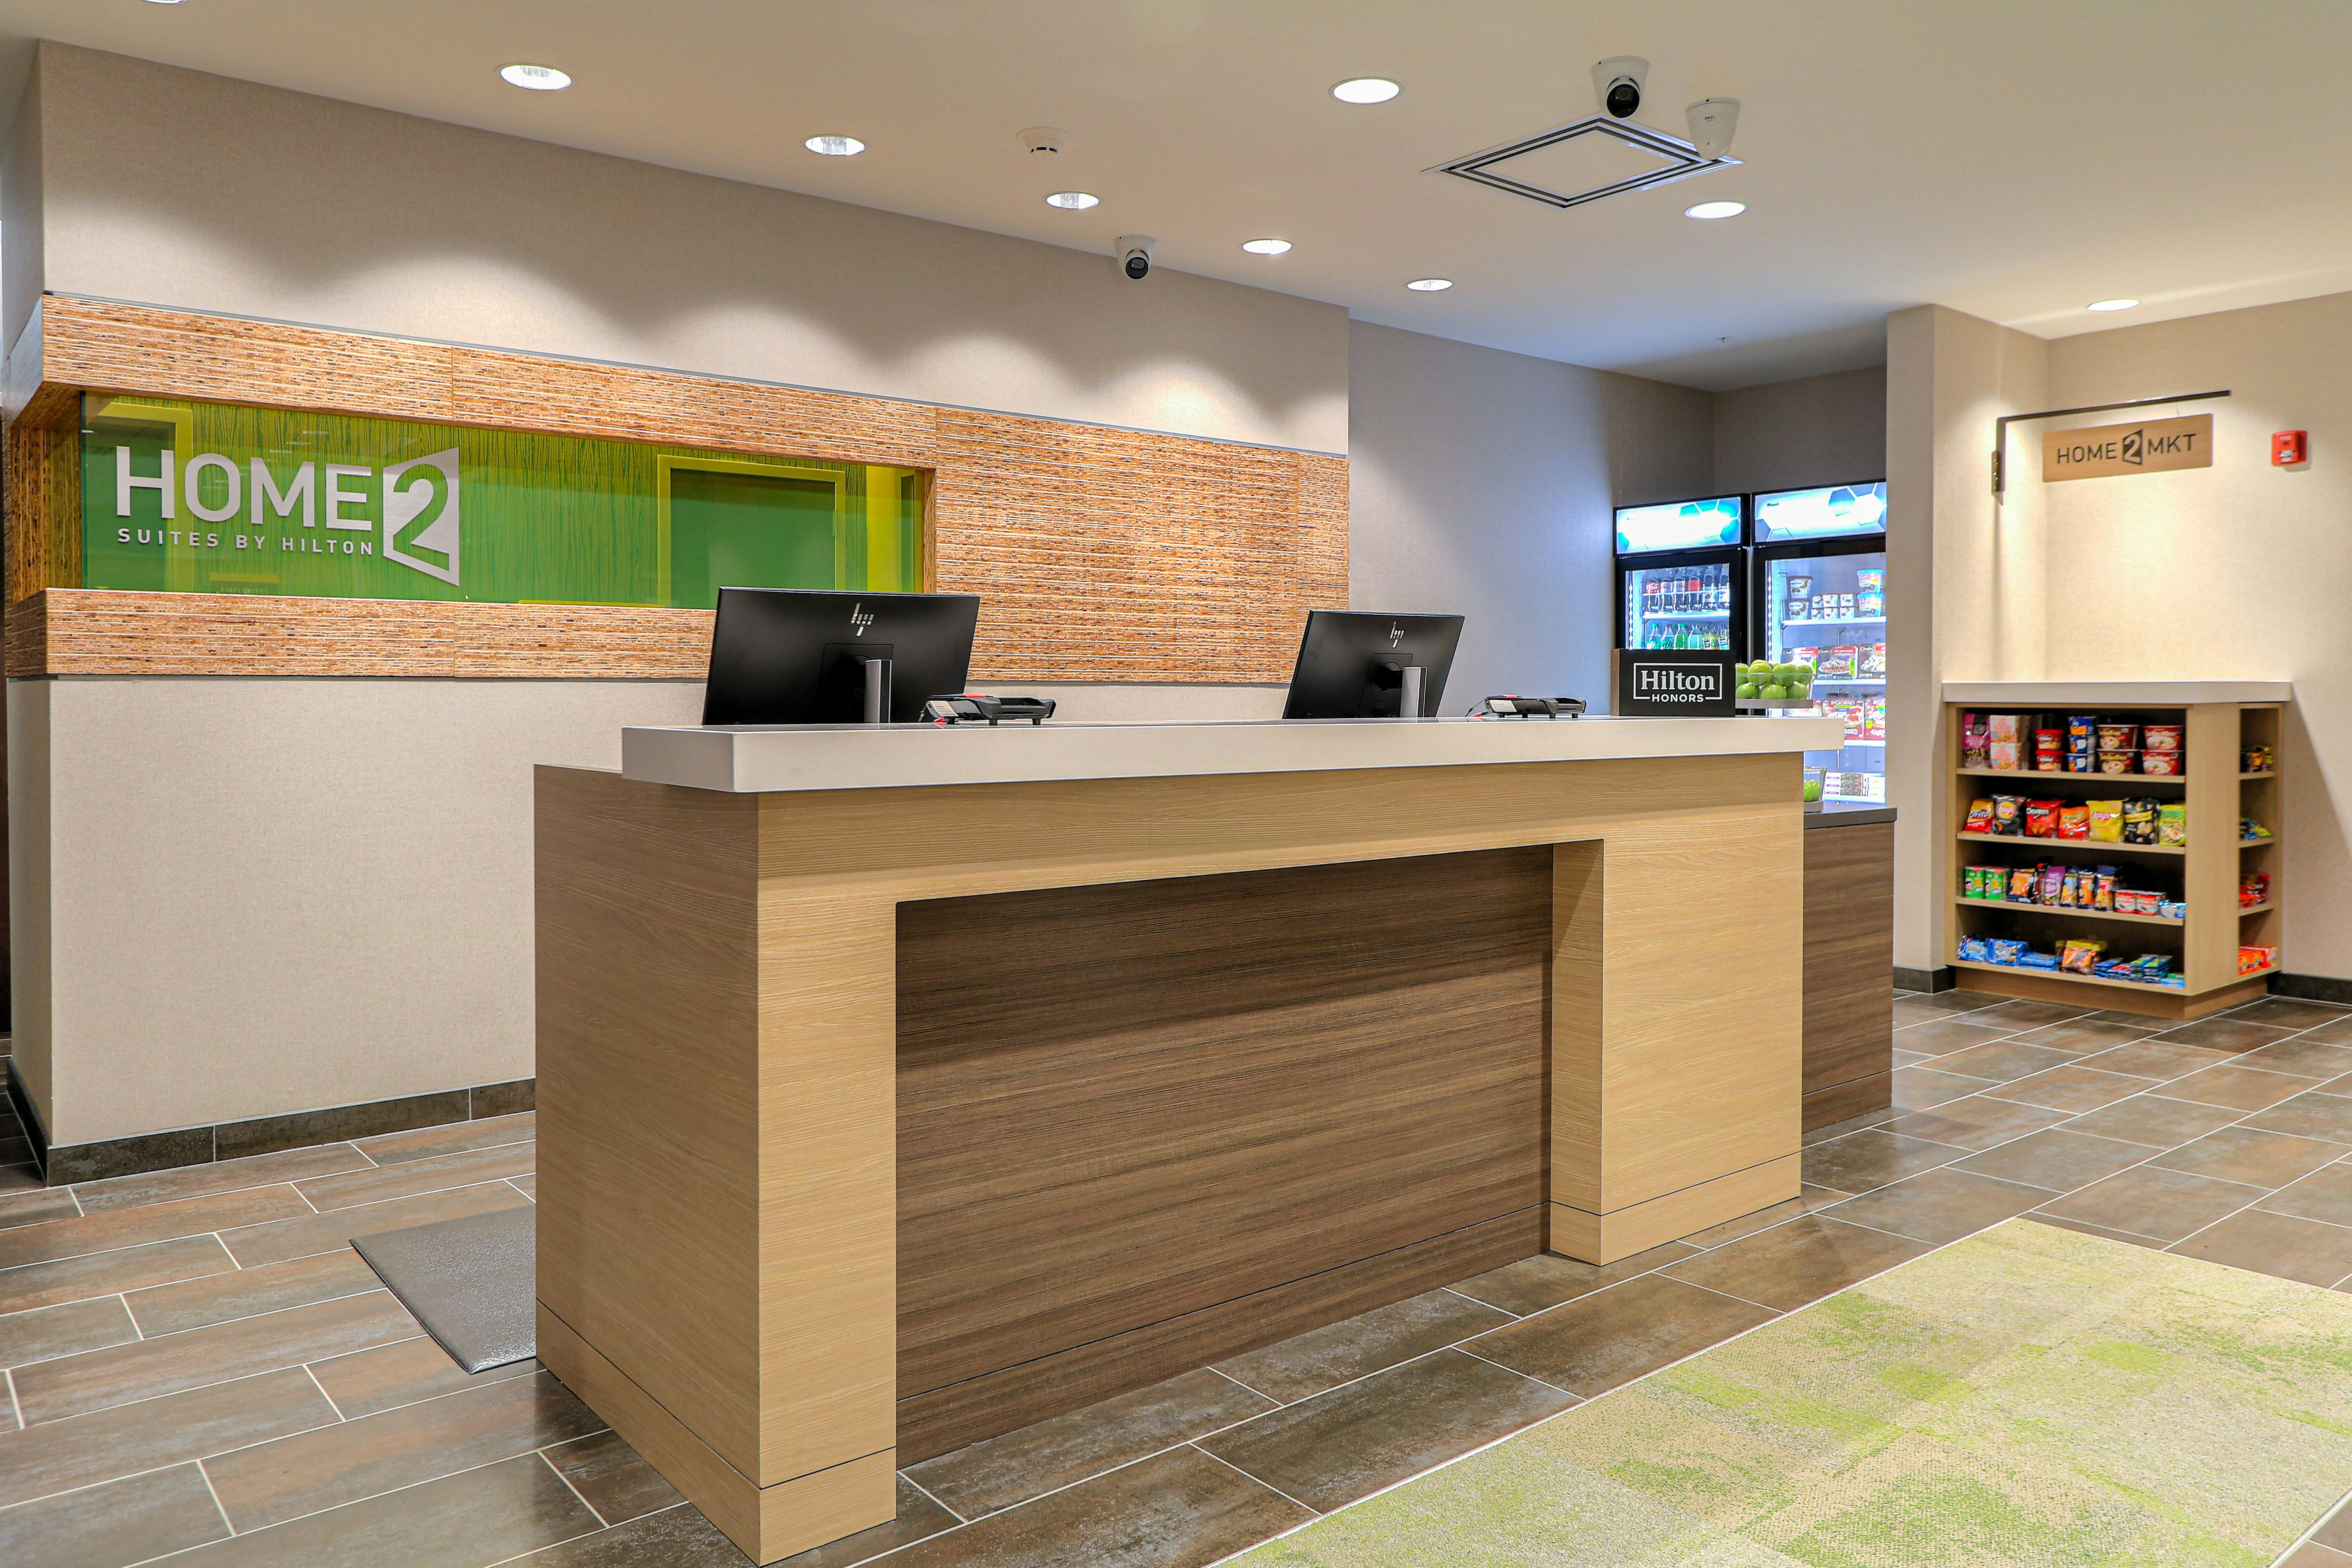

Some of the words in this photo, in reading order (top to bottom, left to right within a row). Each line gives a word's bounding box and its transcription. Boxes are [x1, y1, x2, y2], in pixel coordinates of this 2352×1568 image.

[2057, 442, 2117, 464] HOME
[2148, 433, 2196, 455] MKT
[118, 528, 218, 548] SUITES
[236, 534, 265, 550] BY
[282, 537, 372, 555] HILTON
[1641, 670, 1715, 690] Hilton
[1651, 693, 1704, 703] HONORS
